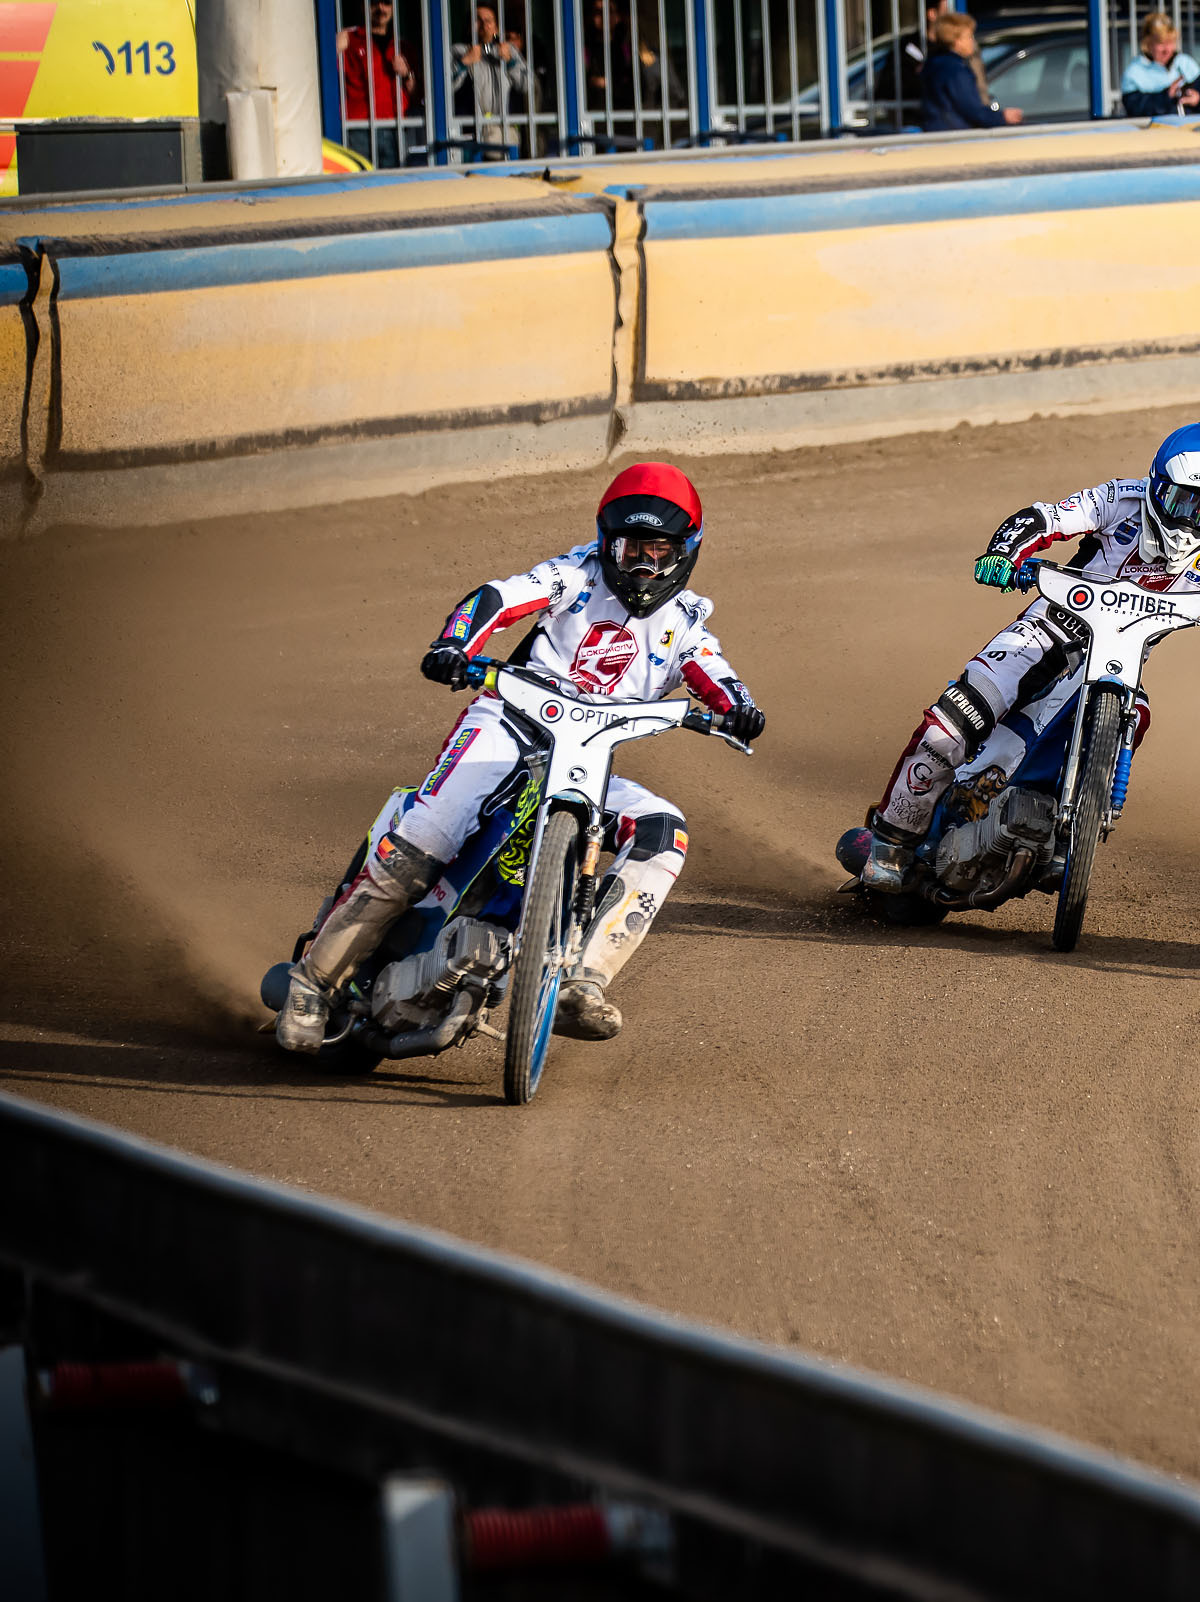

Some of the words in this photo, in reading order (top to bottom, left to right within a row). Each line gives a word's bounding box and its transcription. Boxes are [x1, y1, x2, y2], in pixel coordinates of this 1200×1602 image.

[117, 40, 176, 75] 113
[630, 514, 659, 525] SHOEI
[1101, 590, 1176, 618] OPTIBET
[944, 687, 985, 730] ALPROMO
[455, 731, 471, 748] LESS
